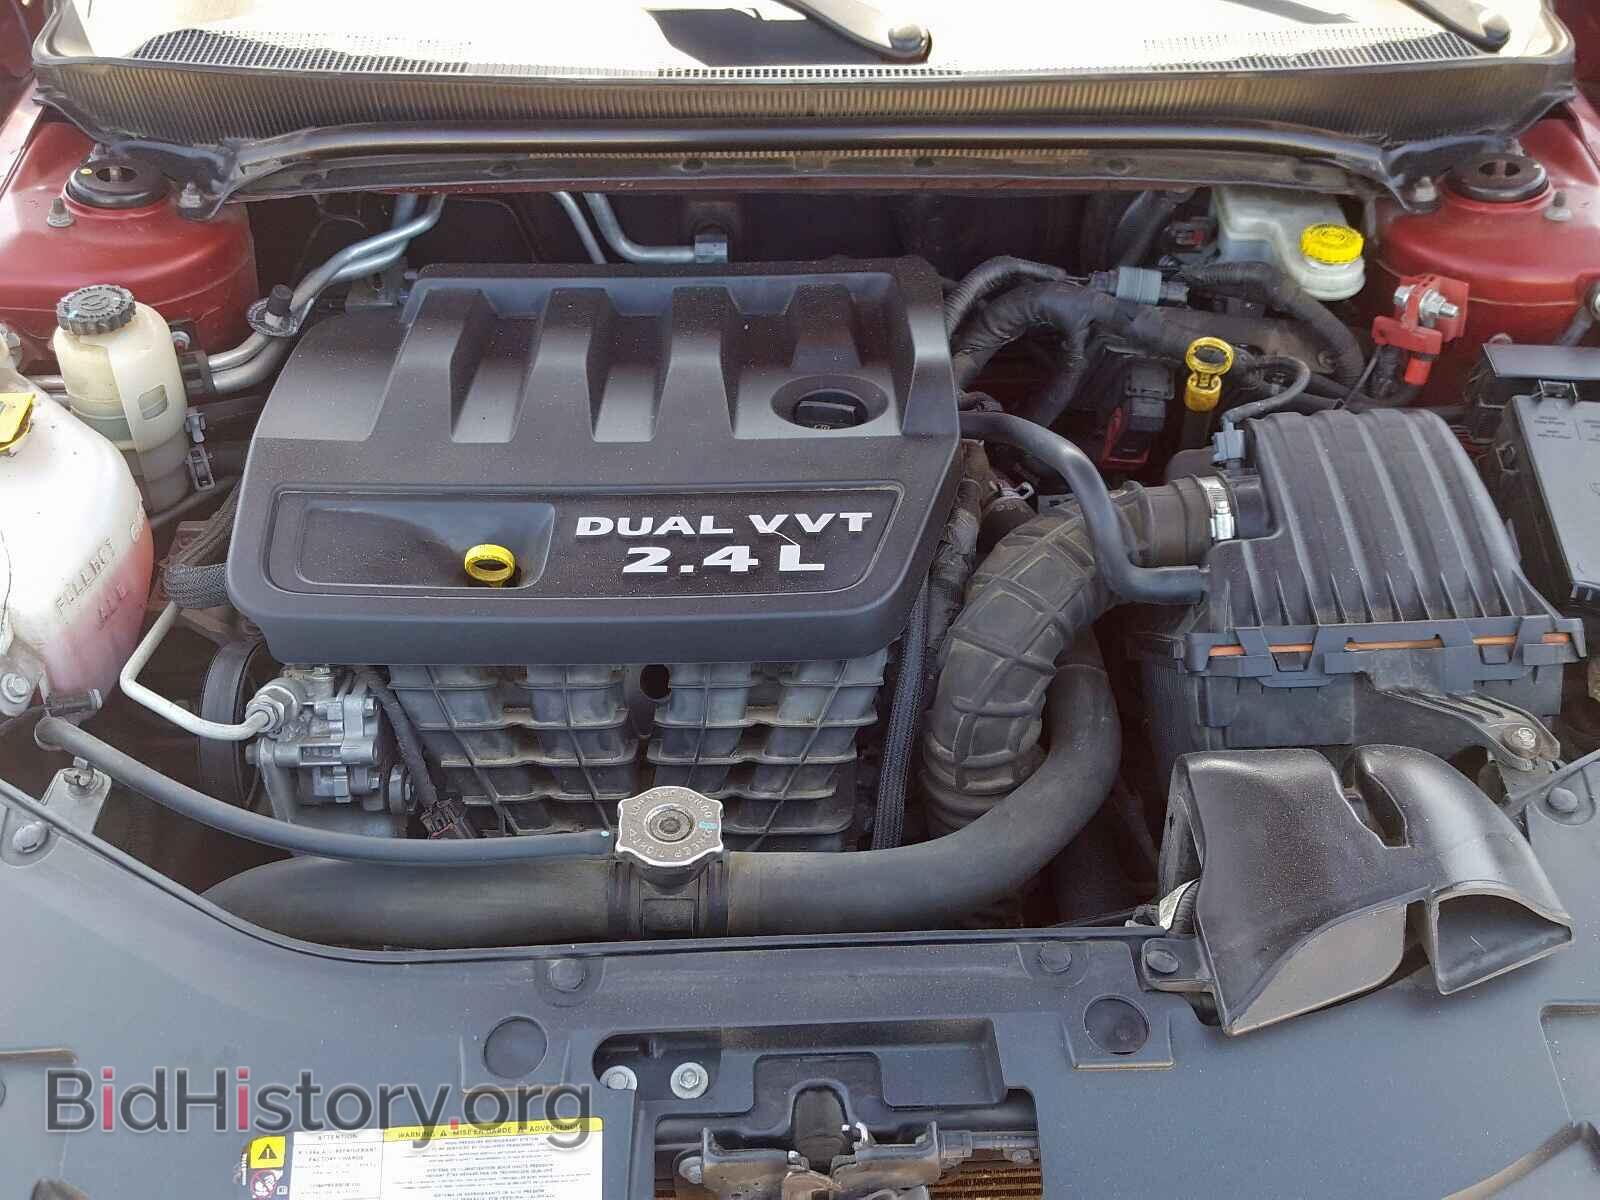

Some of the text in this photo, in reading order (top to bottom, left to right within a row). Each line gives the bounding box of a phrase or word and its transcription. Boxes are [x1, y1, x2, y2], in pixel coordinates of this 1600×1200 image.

[575, 512, 873, 536] DUAL VVT
[398, 1131, 436, 1139] WARNING
